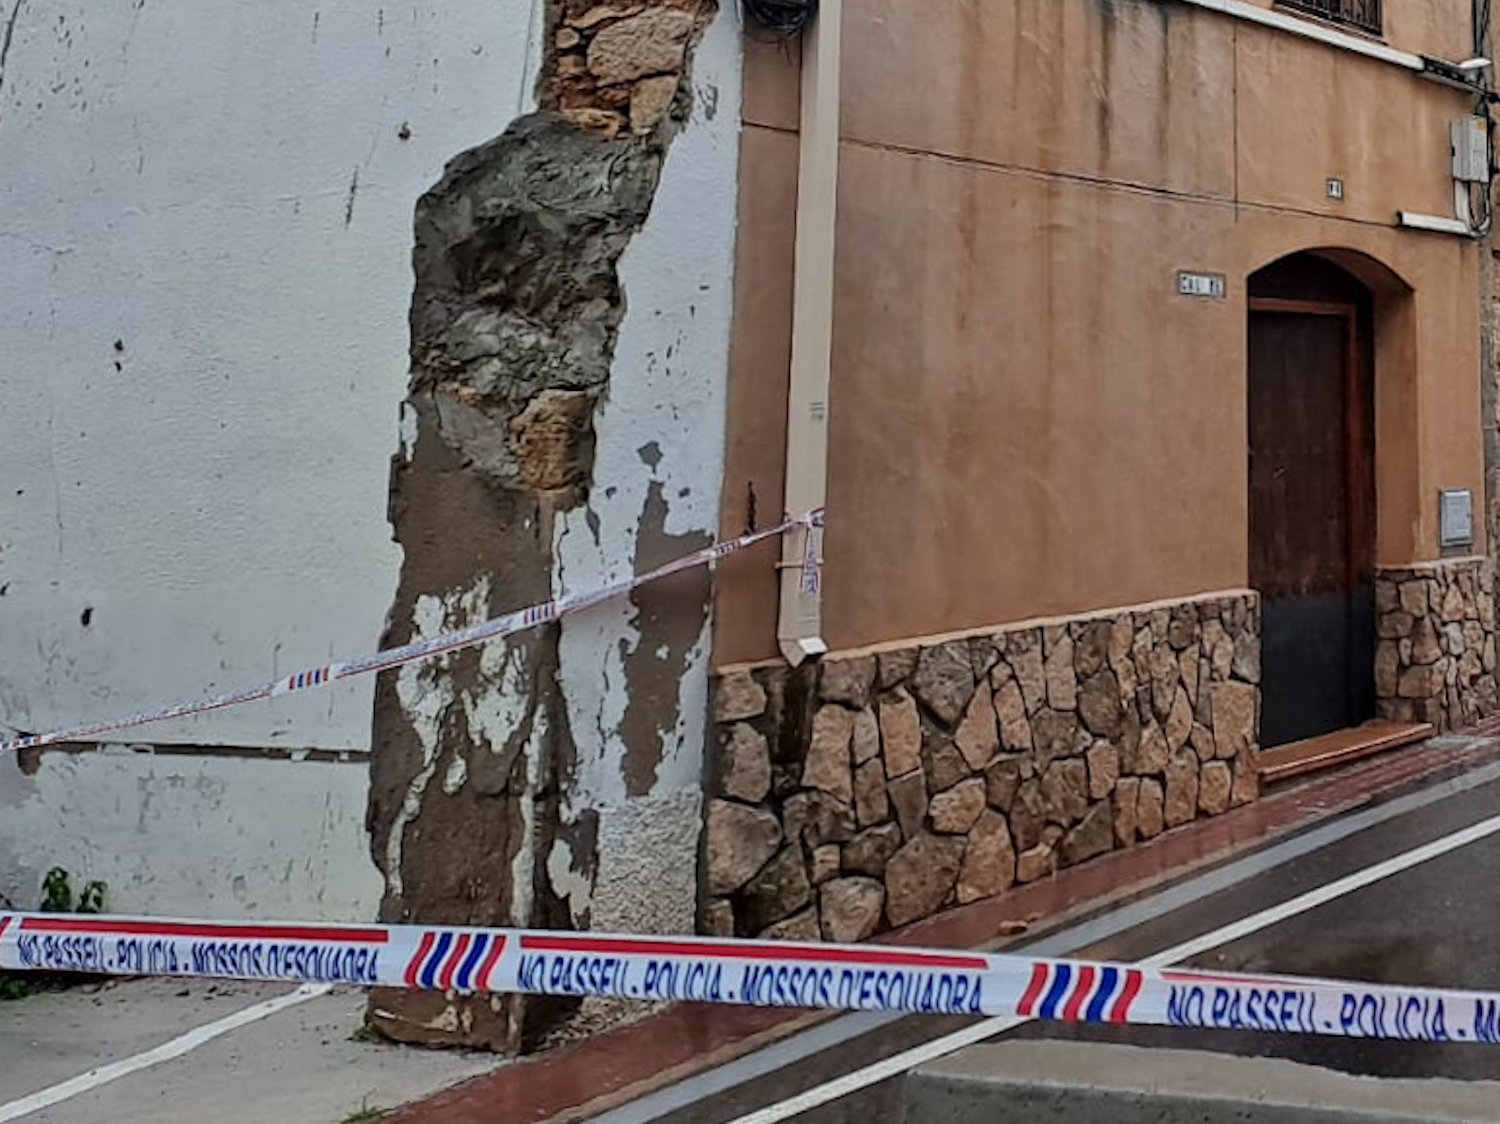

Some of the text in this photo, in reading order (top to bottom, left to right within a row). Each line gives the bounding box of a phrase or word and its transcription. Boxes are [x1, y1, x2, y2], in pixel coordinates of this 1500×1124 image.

[18, 934, 41, 967] NO
[192, 942, 264, 977] MOSSOS
[517, 955, 546, 993] NO
[741, 964, 832, 1008] MOSSOS
[1168, 985, 1204, 1027] NO
